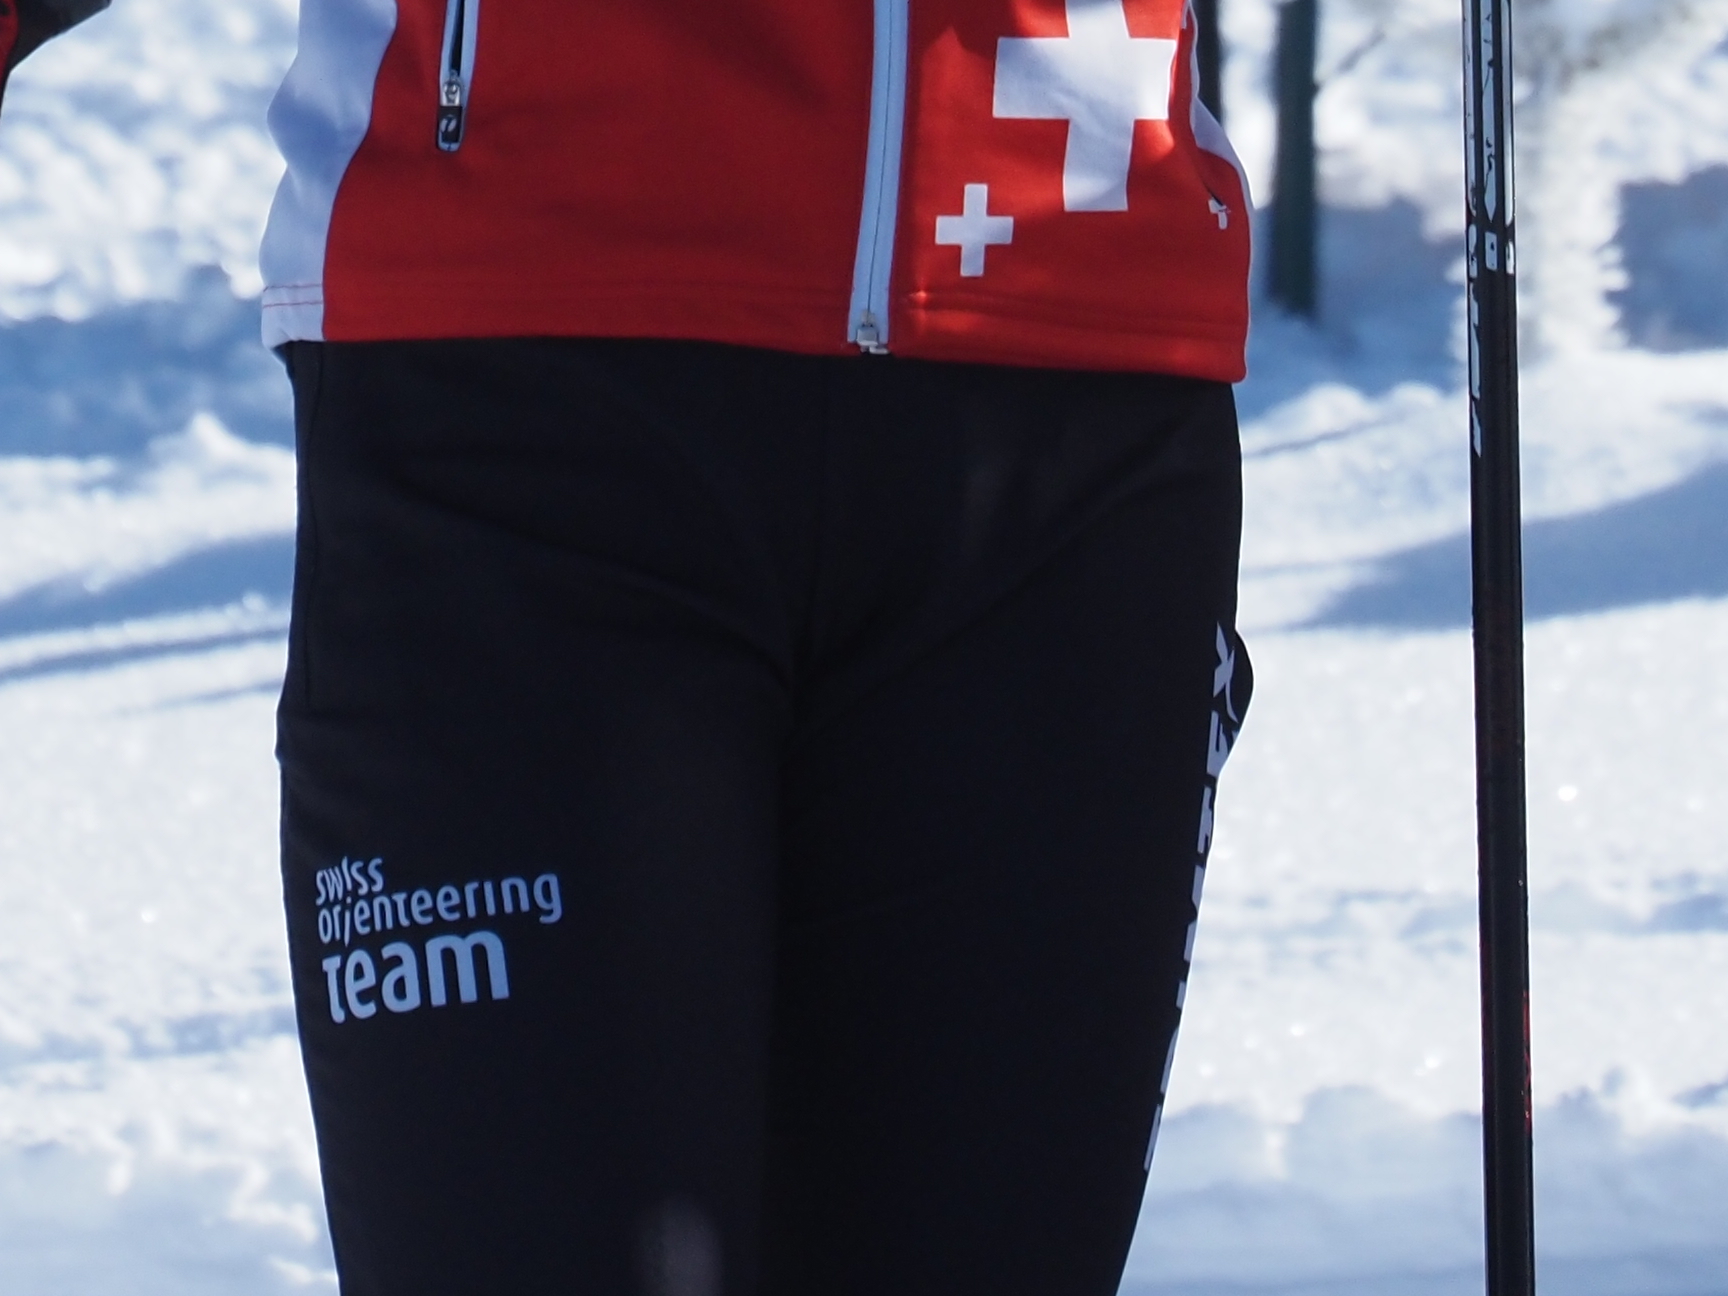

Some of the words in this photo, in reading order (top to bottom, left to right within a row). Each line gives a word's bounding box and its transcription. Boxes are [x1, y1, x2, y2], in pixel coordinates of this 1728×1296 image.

[315, 856, 384, 906] swiss
[317, 873, 563, 947] orienteering
[322, 930, 510, 1024] team
